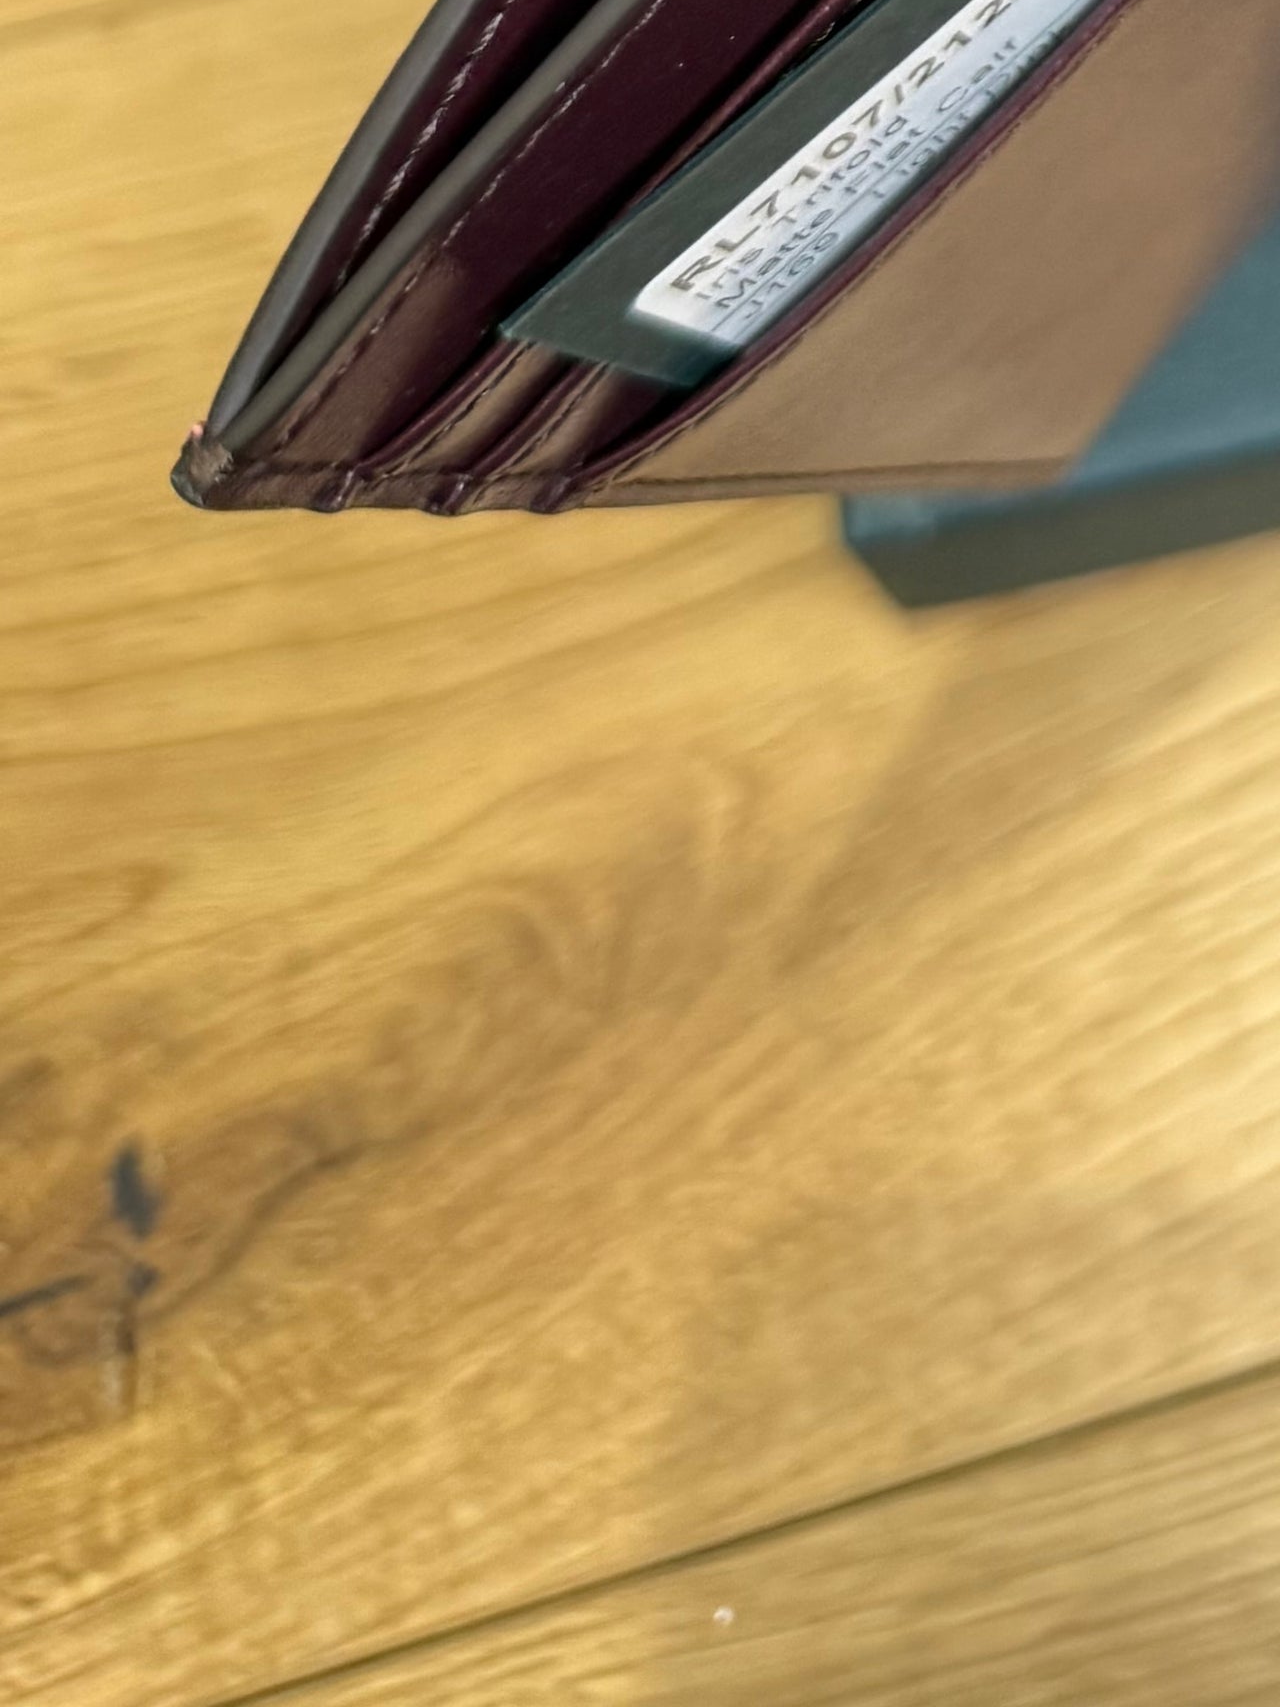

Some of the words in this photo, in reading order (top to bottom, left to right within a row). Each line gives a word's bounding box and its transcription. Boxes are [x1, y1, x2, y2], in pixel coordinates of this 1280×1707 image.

[696, 247, 764, 300] Iris
[766, 115, 908, 229] Trifold
[714, 208, 834, 309] Matte
[841, 126, 925, 194] Flat
[938, 40, 1018, 113] Calf
[744, 232, 839, 319] J169
